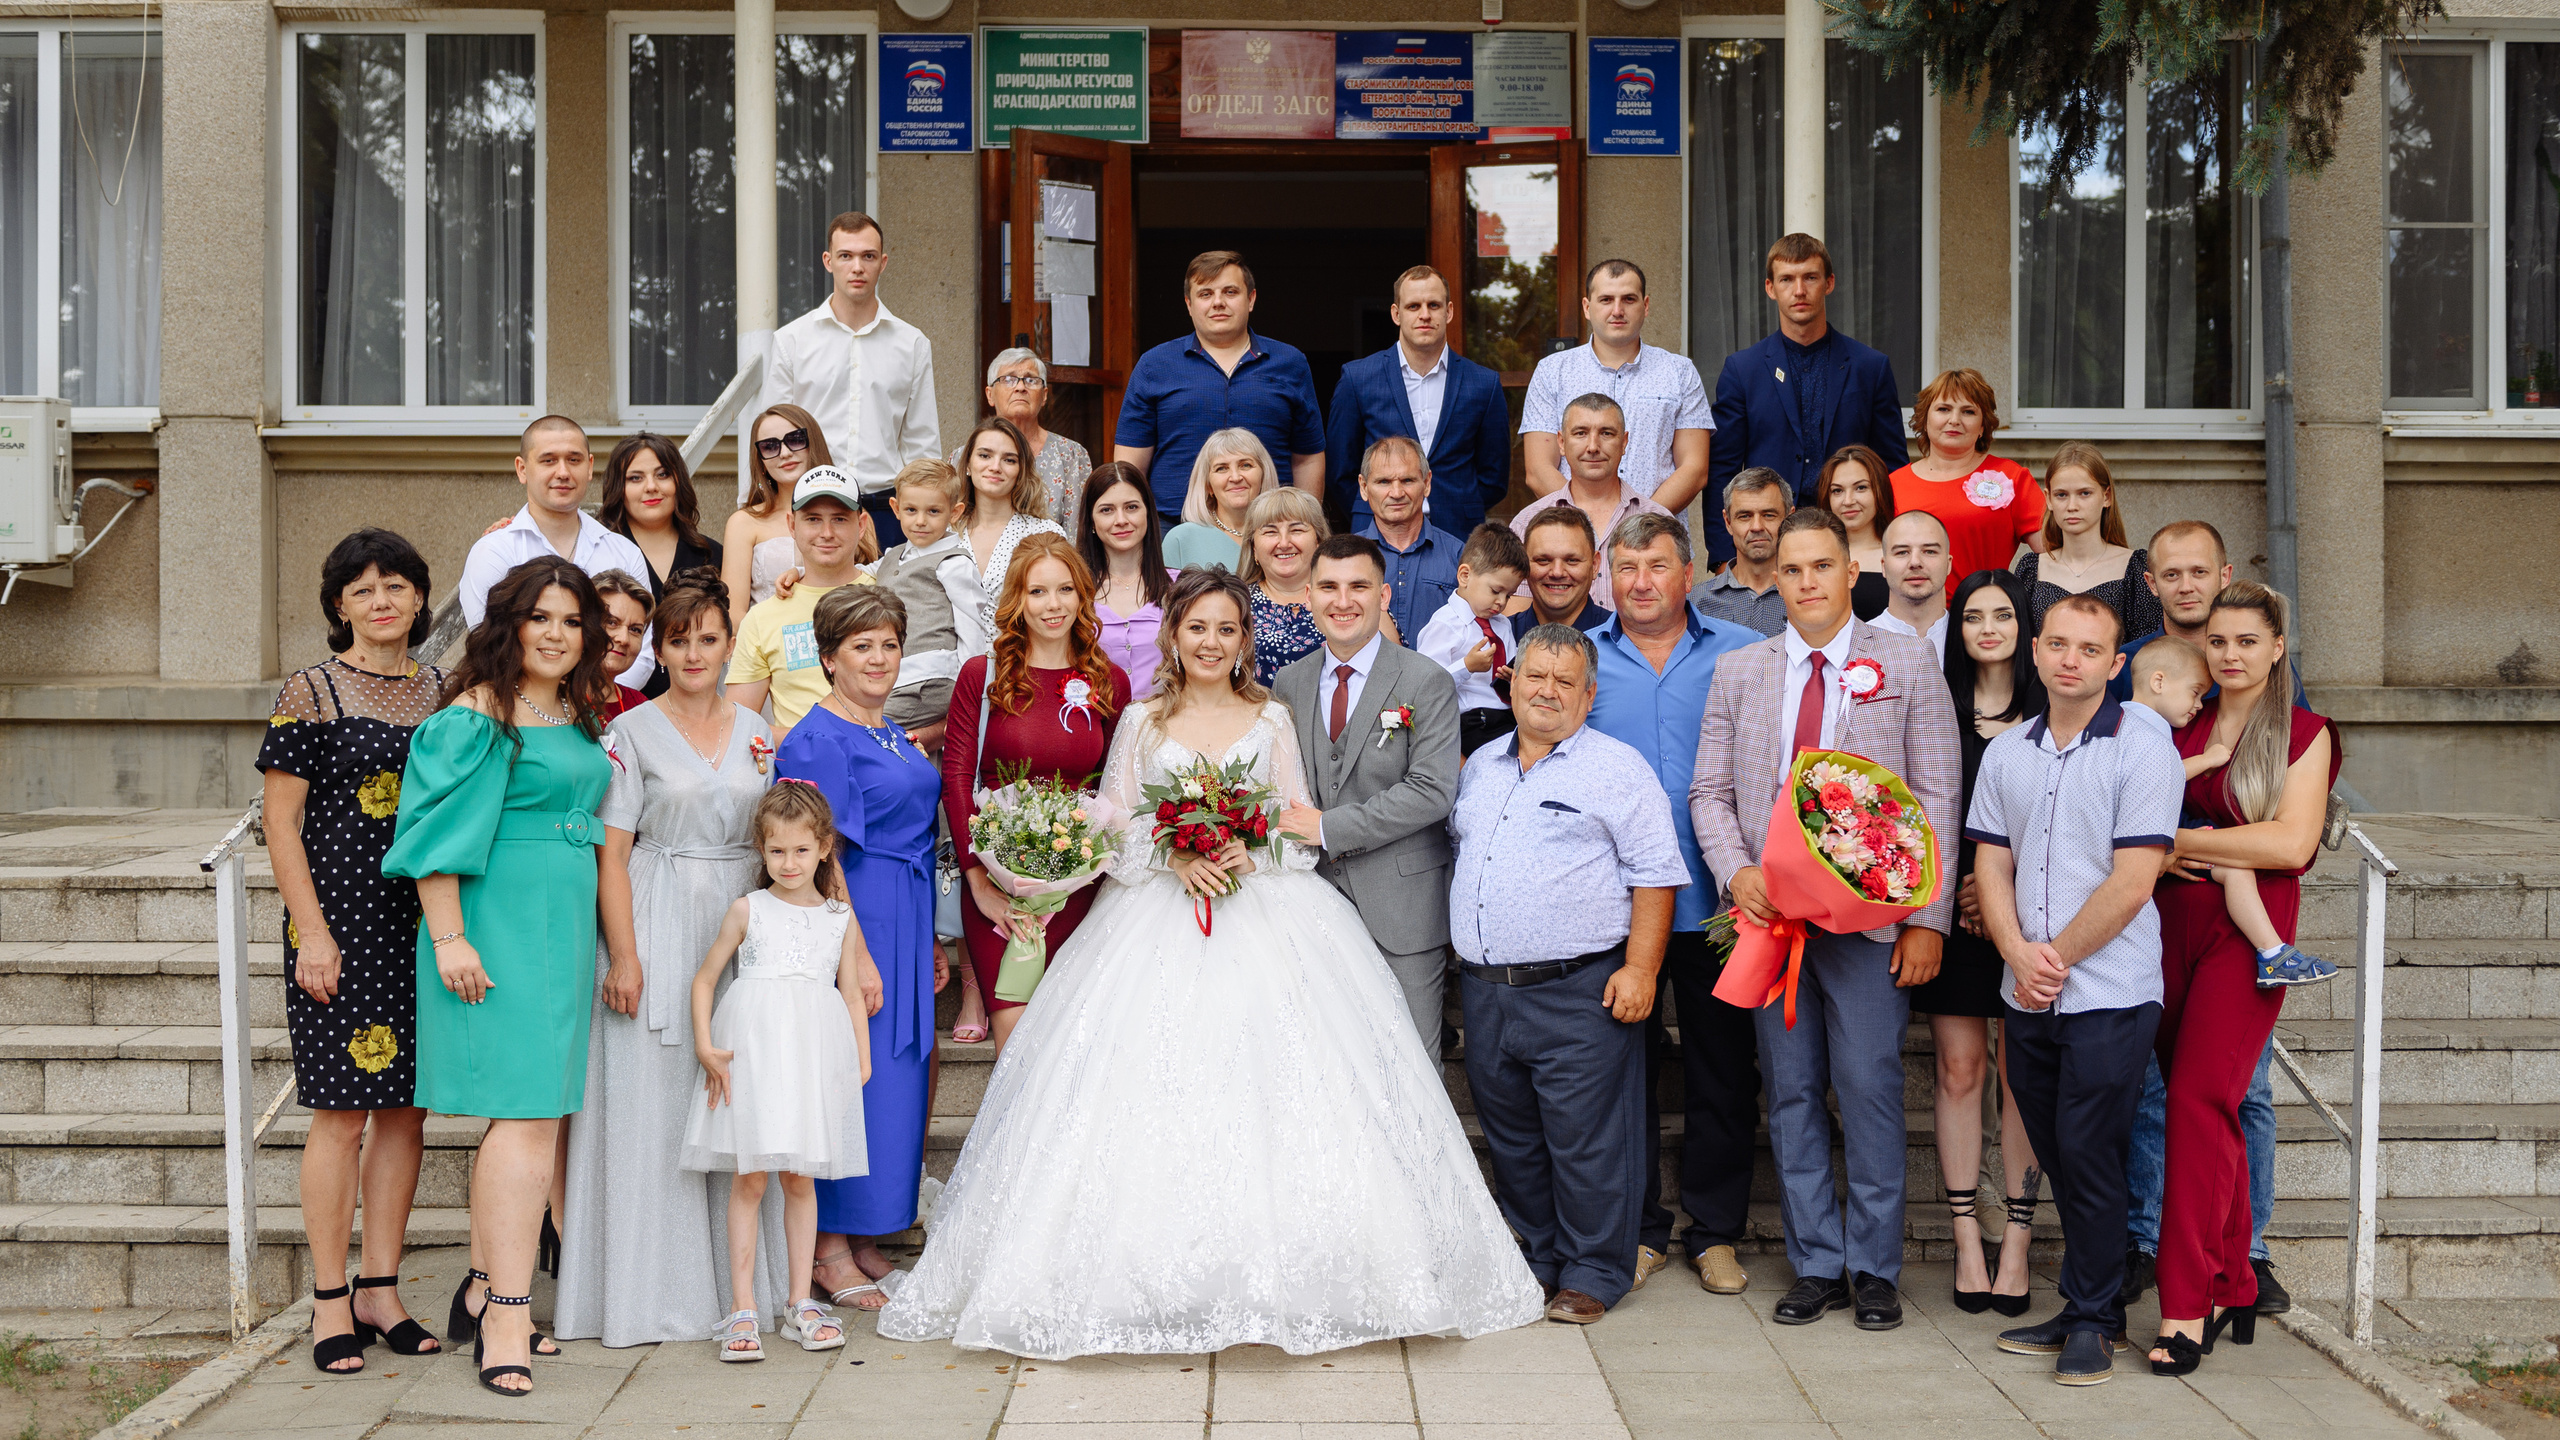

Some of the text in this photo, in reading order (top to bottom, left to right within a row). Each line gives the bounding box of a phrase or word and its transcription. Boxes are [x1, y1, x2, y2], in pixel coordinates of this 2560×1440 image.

[1020, 53, 1109, 67] МИНИСТЕРСТВО
[1363, 56, 1461, 65] РОССИЙСКАЯ ФЕДЕРАЦИЯ
[996, 74, 1133, 89] ПРИРОДНЫХ РЕСУРСОВ
[1345, 77, 1474, 90] СТАРОМИНСКИЙ РАЙОННЫЙ СОВЕ
[1499, 84, 1544, 92] 9.00-18.00
[993, 95, 1135, 110] КРАСНОДАРСКОГО КРАЯ
[1361, 91, 1463, 105] ВЕТЕРАНОВ ВОЙНЫ, ТРУДА
[1187, 94, 1329, 118] ОТДЕЛ ЗАГС
[1435, 108, 1451, 118] СИЛ
[885, 122, 932, 130] ОБЩЕСТВЕННАЯ
[1213, 122, 1303, 132] Староминского района
[1343, 122, 1350, 131] И
[1350, 122, 1444, 132] ПРАВООХРАНИТЕЛЬНЫХ
[923, 138, 958, 146] ОТДЕЛЕНИЯ
[1631, 137, 1664, 145] ОТДЕЛЕНИЕ
[805, 470, 847, 484] NEW YORK
[788, 662, 799, 670] PEPE
[799, 659, 814, 667] JEANS
